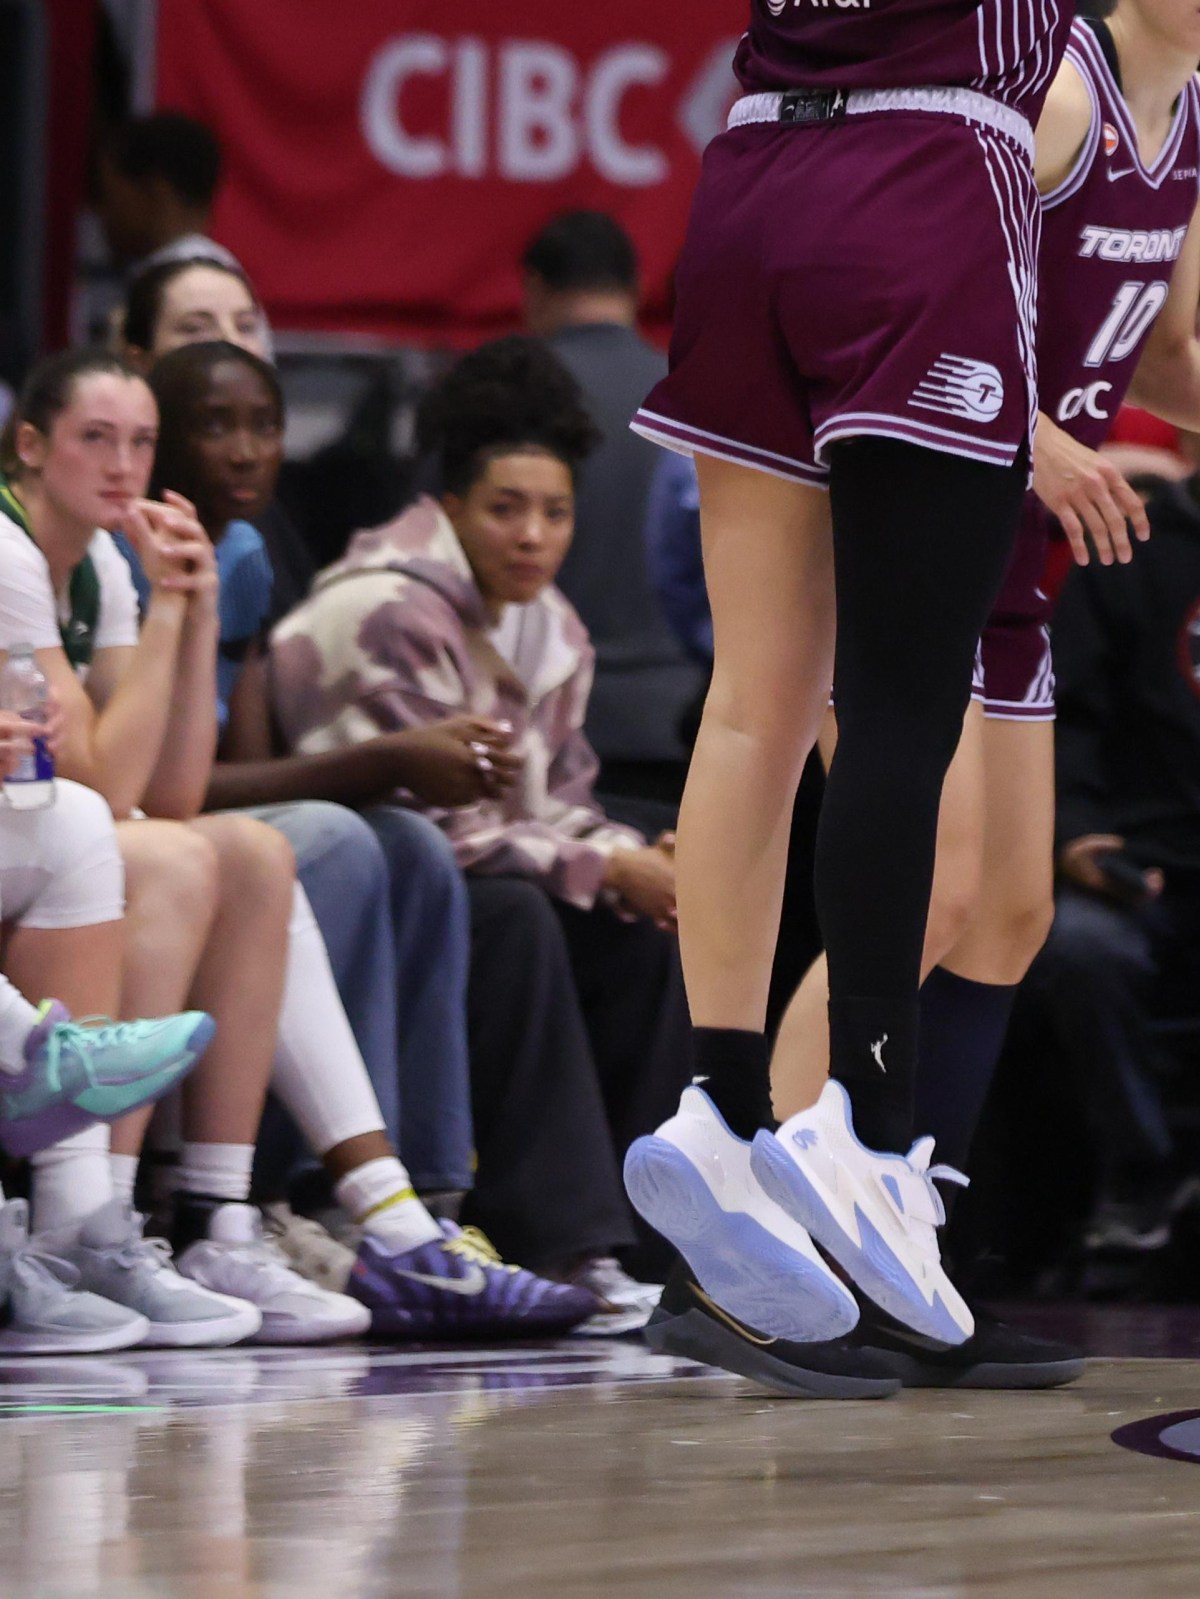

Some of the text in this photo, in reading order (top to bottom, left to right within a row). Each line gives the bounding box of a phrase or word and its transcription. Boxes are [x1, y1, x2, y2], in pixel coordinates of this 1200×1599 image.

[360, 32, 669, 188] CIBC
[1078, 224, 1188, 263] TORONT
[1082, 280, 1169, 368] 10
